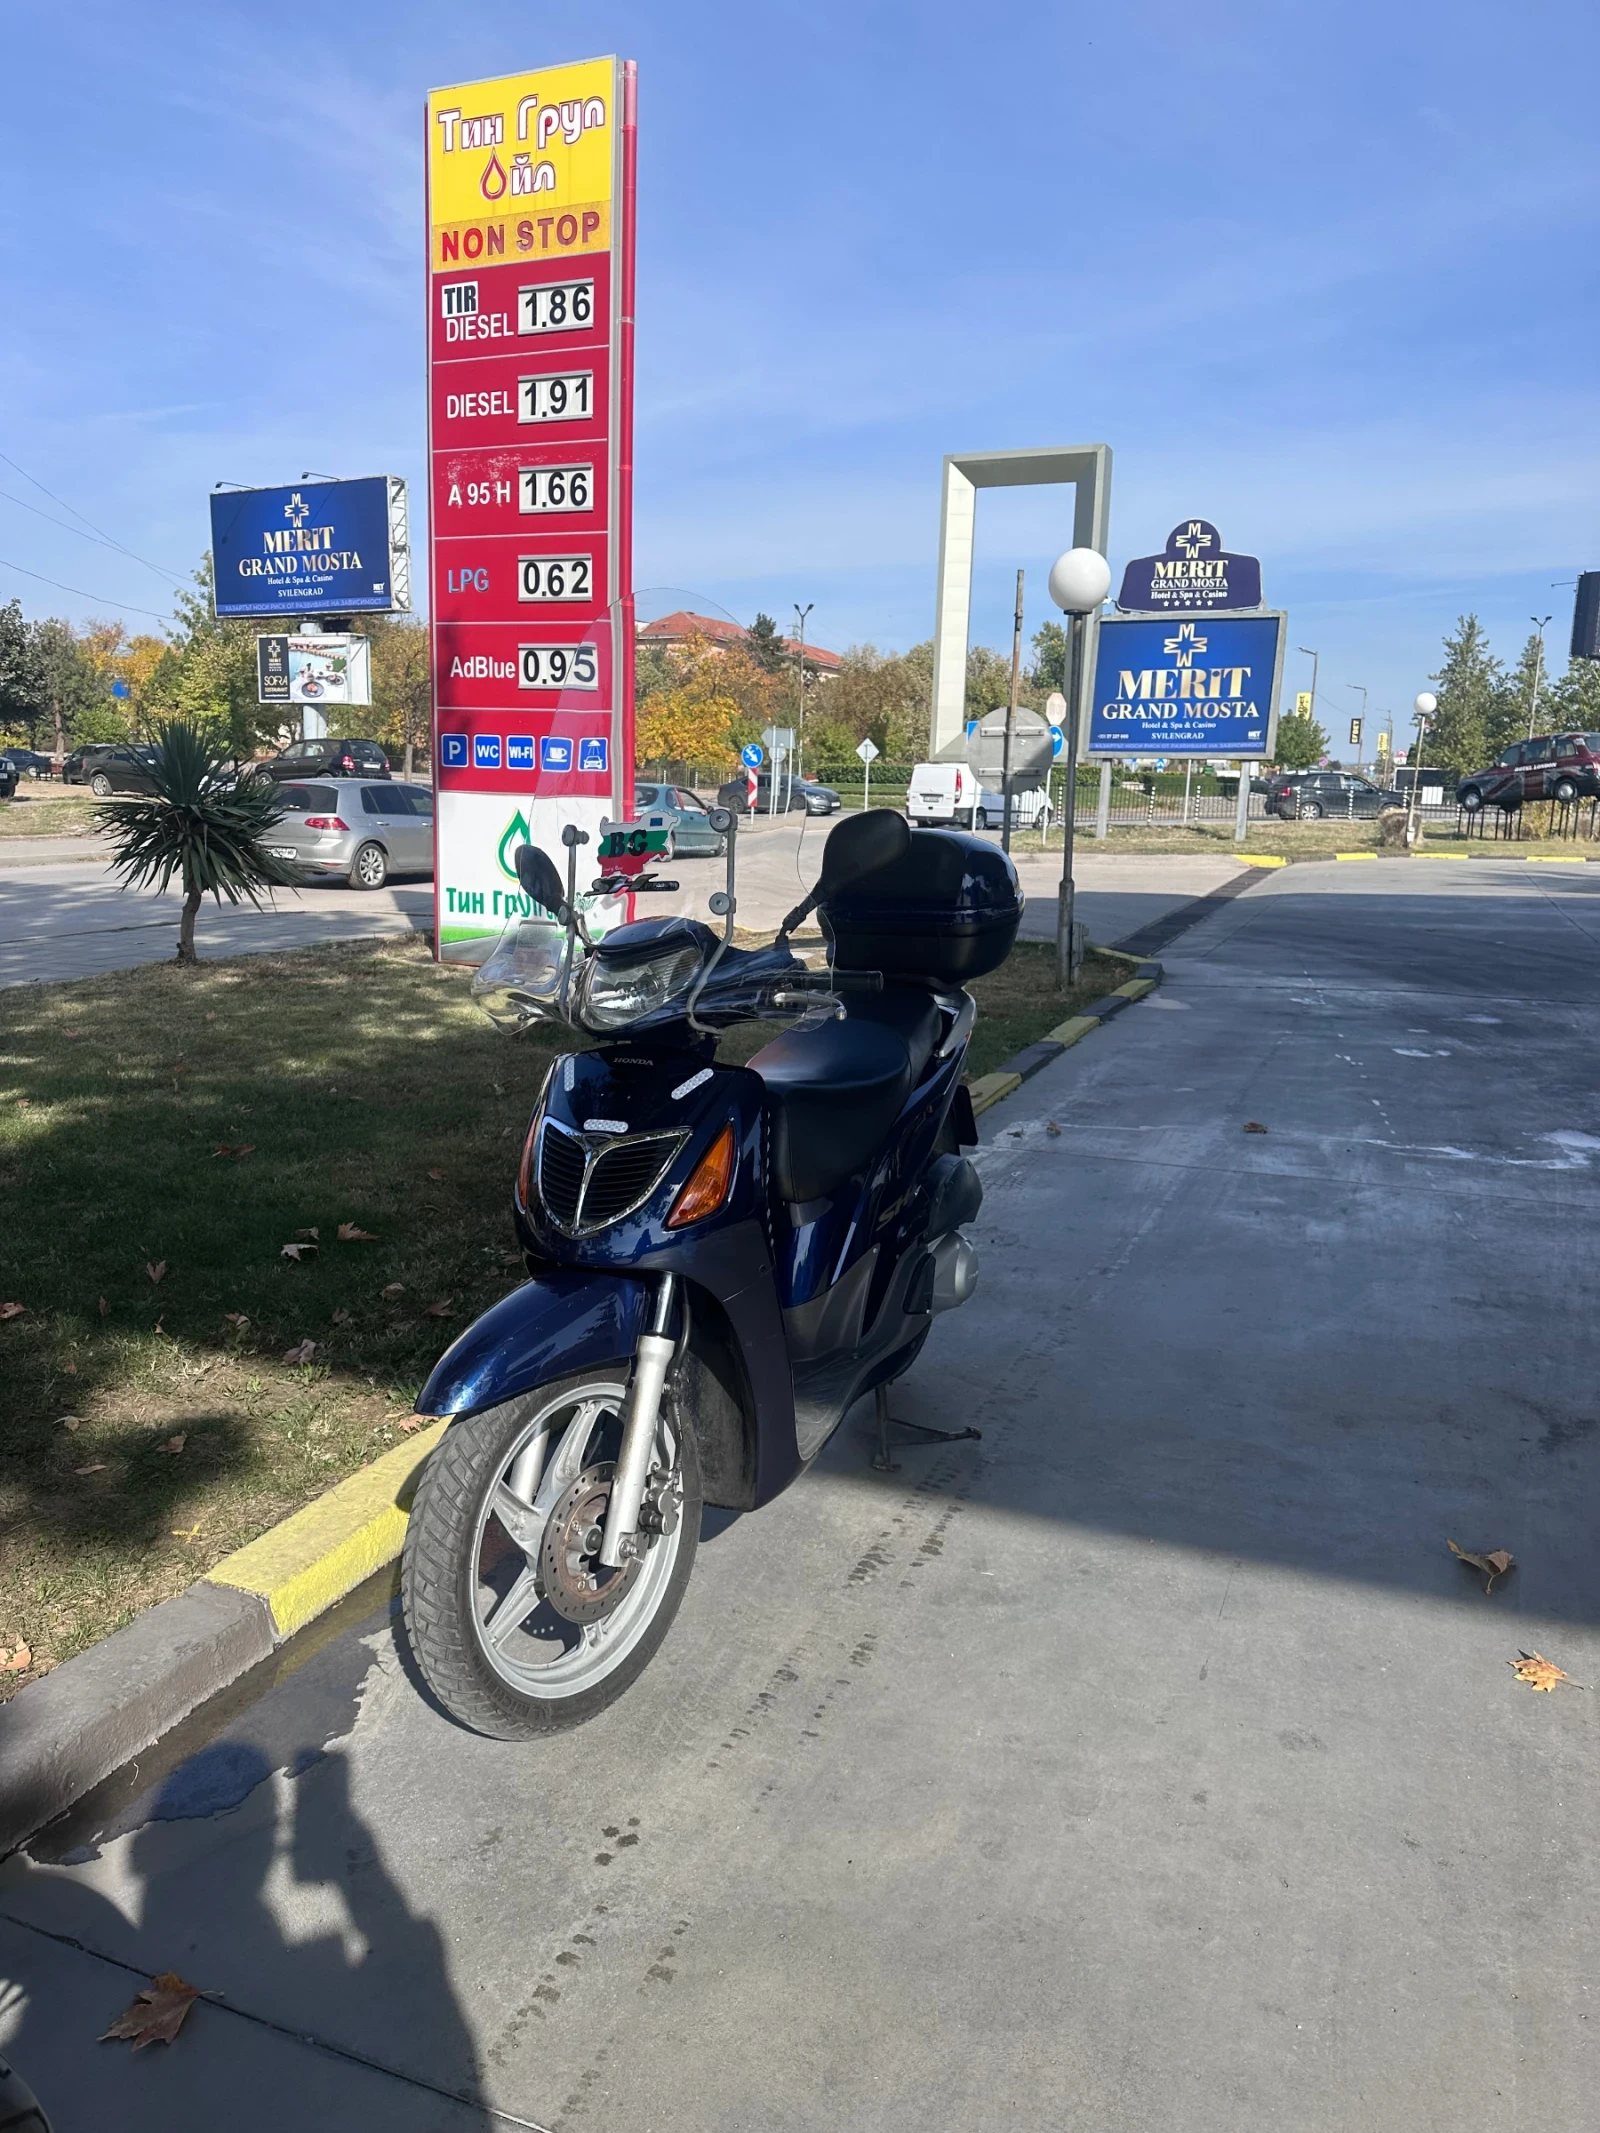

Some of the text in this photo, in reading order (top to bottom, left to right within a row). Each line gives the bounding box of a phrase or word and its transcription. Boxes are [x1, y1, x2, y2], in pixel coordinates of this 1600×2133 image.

[437, 95, 606, 153] Тин Груп
[442, 211, 600, 262] NON STOP
[444, 285, 477, 315] TIR
[446, 286, 591, 342] DIESEL 1.86
[447, 377, 588, 418] DIESEL 1.91
[467, 482, 491, 506] 95
[524, 471, 588, 508] 1.66
[238, 551, 363, 577] GRAND MOSTA
[267, 576, 284, 585] Hotel
[292, 575, 304, 585] Spa
[312, 574, 334, 583] Casino
[448, 561, 589, 597] LPG 0.62
[1151, 578, 1228, 589] GRAND MOSTA
[278, 587, 324, 598] SVILENGRAD
[1151, 591, 1171, 600] Hotel
[1179, 590, 1194, 600] Spa
[1202, 590, 1228, 598] Casino
[450, 649, 596, 684] AdBlue 0.95
[1102, 701, 1259, 720] GRAND MOSTA
[1142, 721, 1160, 729] Hotel
[1170, 722, 1184, 730] Spa
[1192, 721, 1217, 729] Casino
[1151, 732, 1205, 740] SVILENGRAD
[477, 744, 499, 758] WC
[509, 745, 533, 760] WI-FI
[608, 829, 649, 858] BG
[445, 887, 484, 915] Тин
[613, 1057, 654, 1066] HONDA
